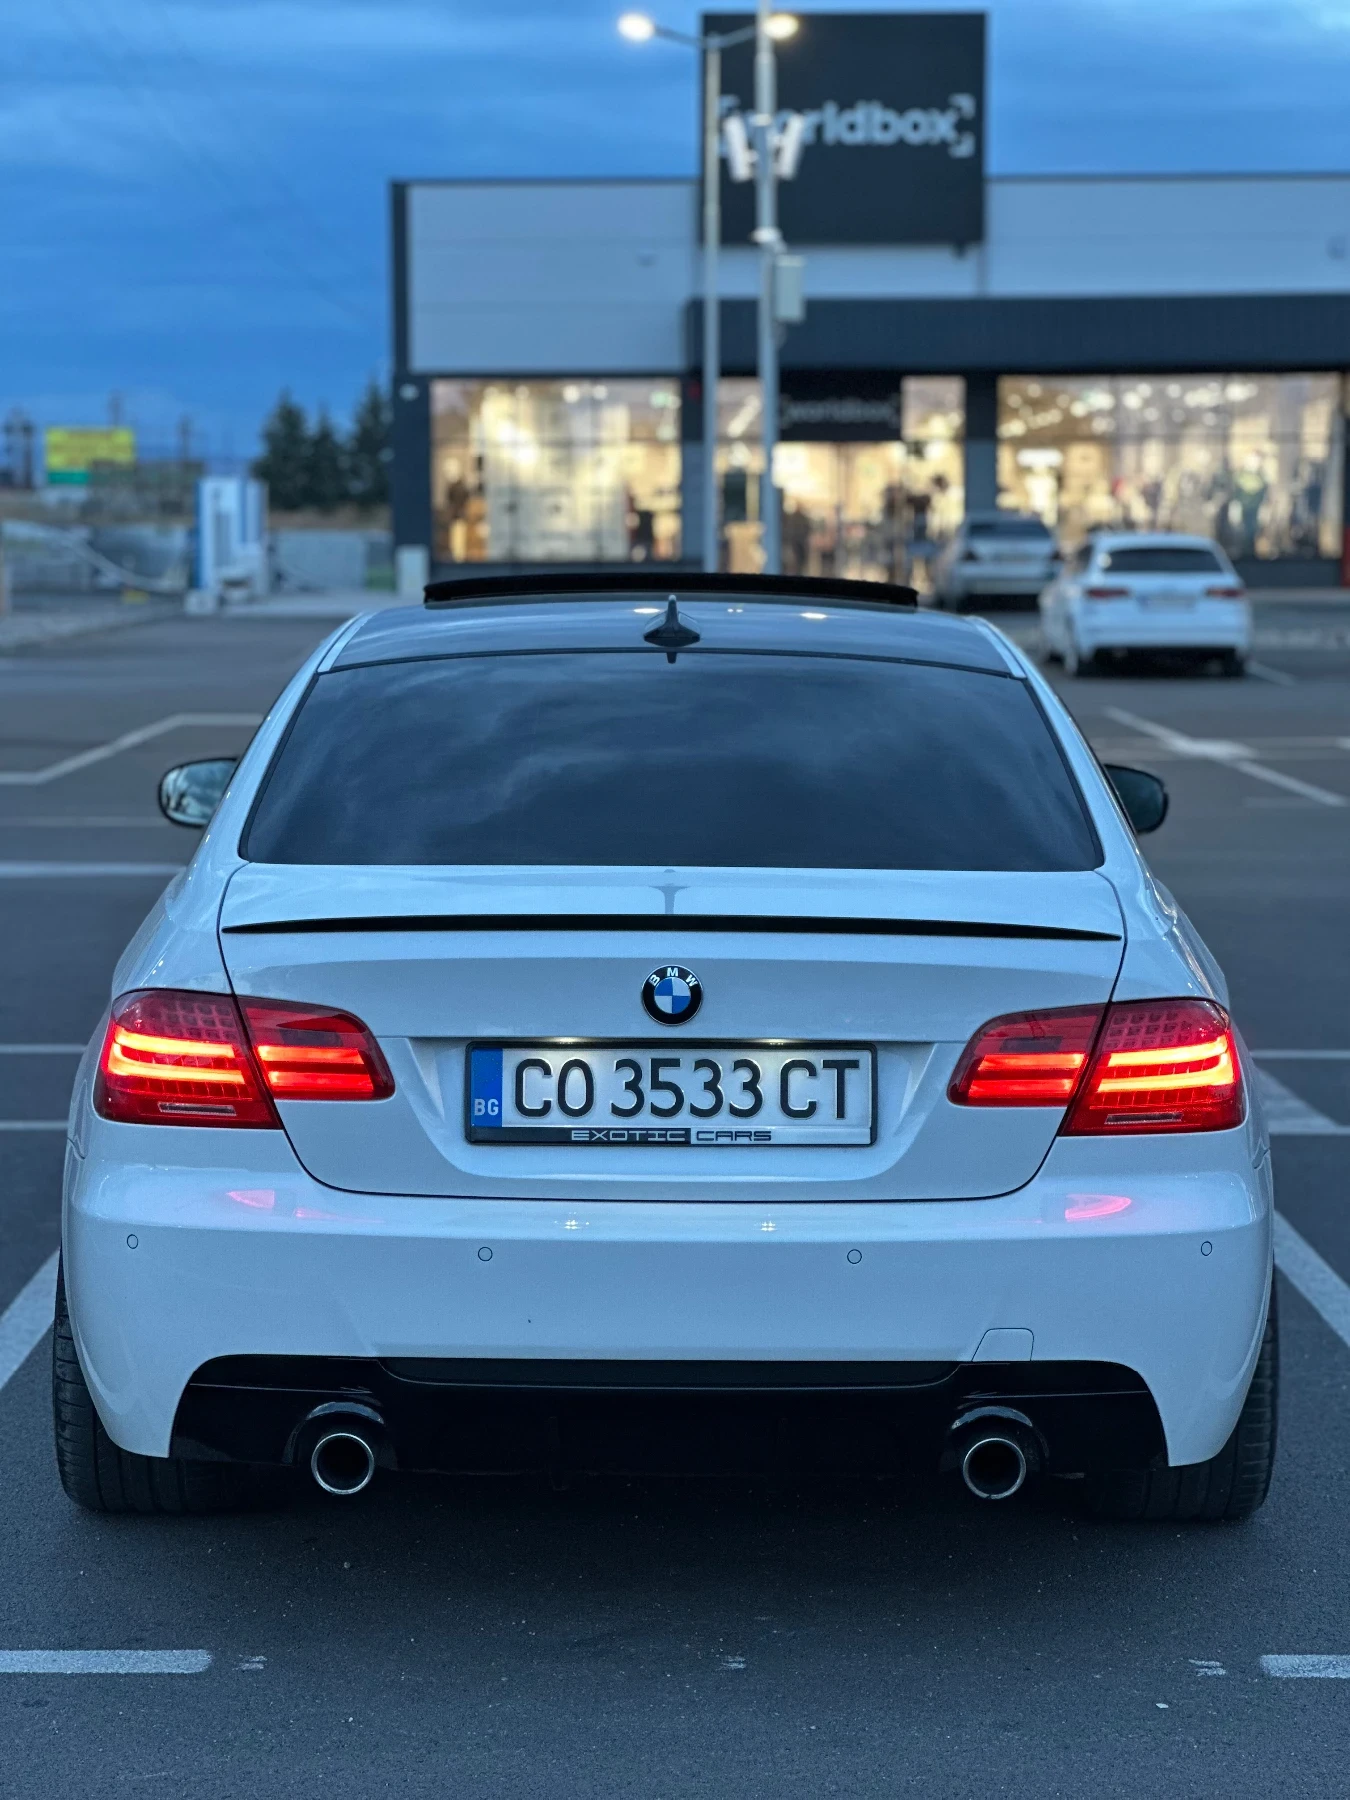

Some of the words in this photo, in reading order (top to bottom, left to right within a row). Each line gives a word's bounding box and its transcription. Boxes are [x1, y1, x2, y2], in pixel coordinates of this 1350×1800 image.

[734, 99, 957, 146] orldbox
[648, 967, 698, 986] BMW
[610, 1058, 764, 1119] 3533
[779, 1058, 860, 1120] CT
[474, 1099, 499, 1116] BG
[571, 1130, 685, 1142] EXOTIC
[696, 1130, 772, 1142] CARS
